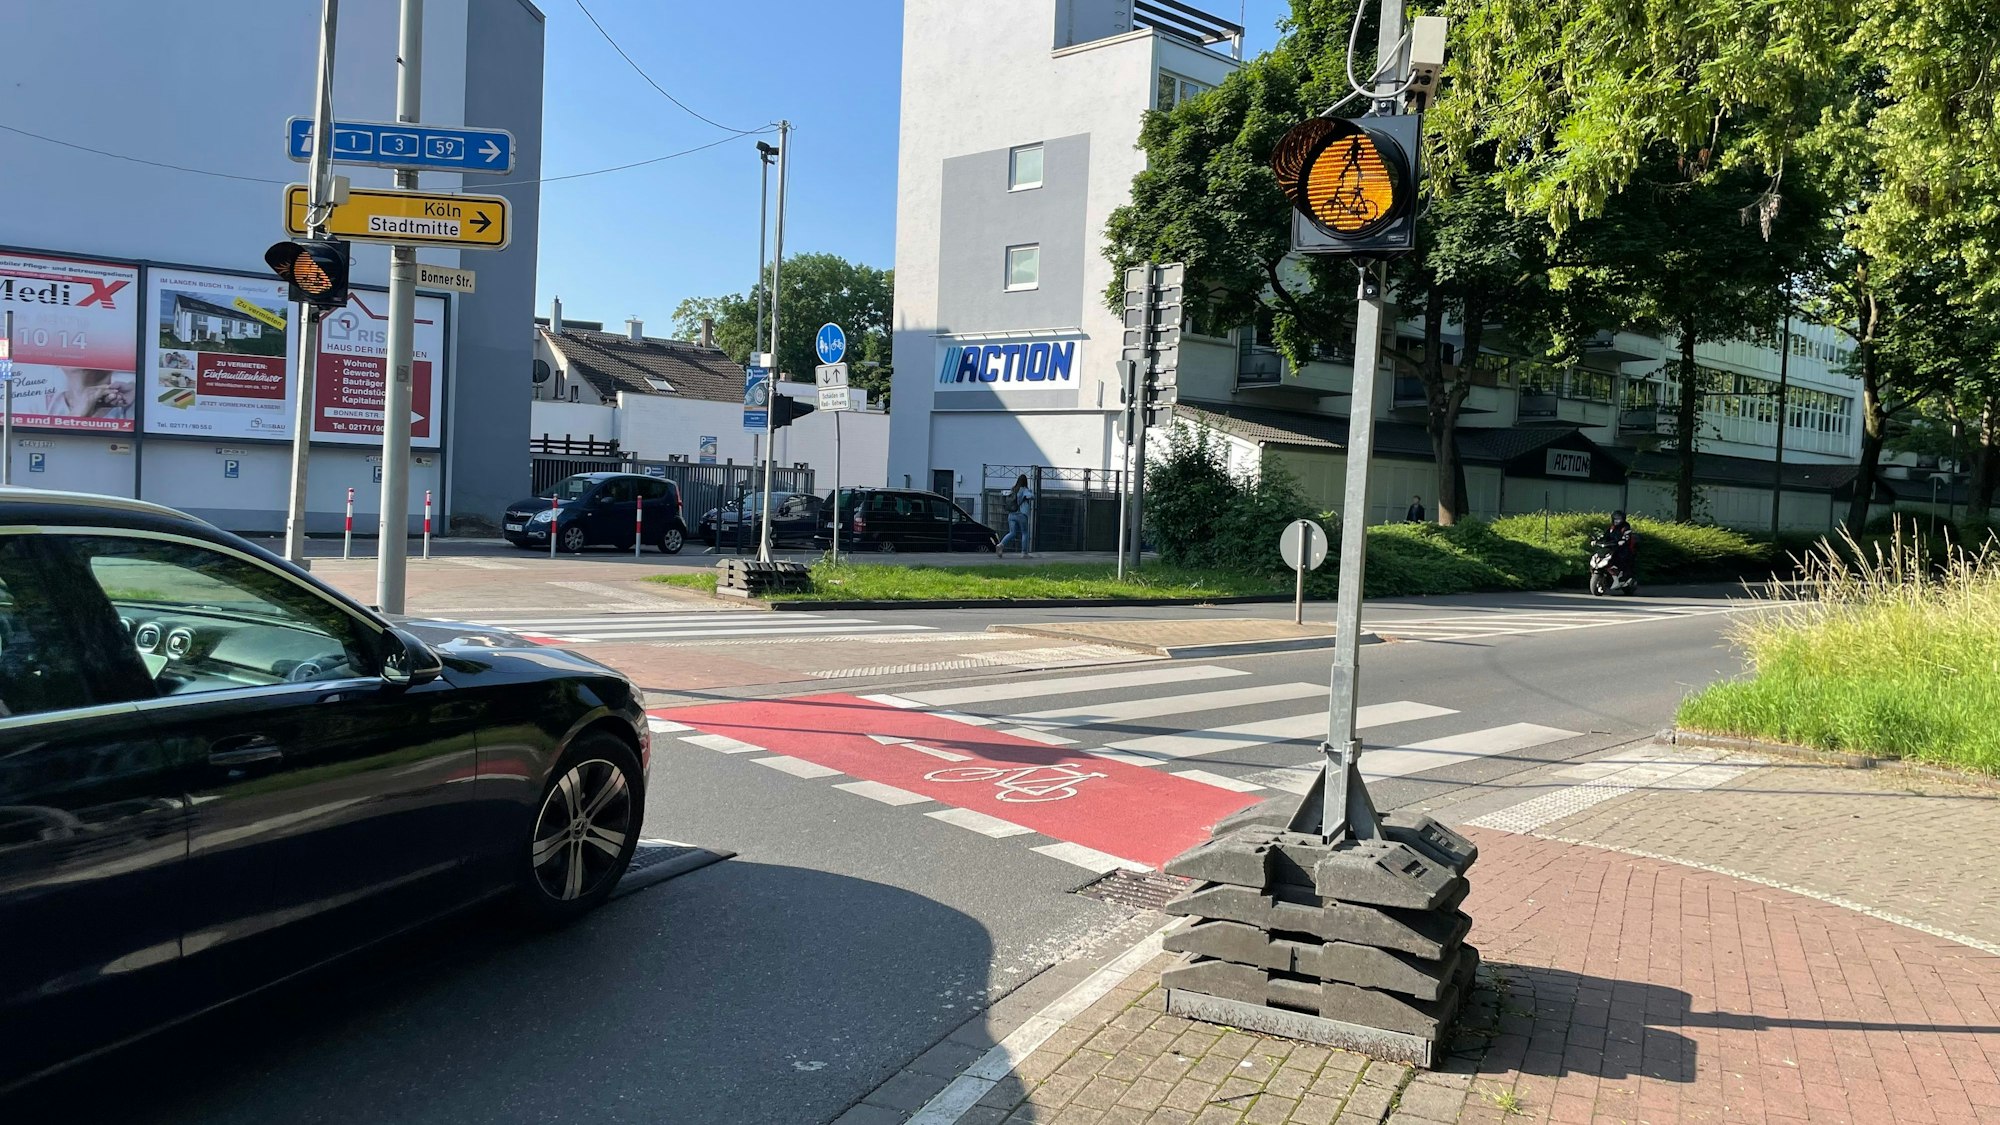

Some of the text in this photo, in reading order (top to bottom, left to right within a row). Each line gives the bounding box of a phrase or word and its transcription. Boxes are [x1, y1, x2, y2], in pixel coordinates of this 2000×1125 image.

[350, 135, 454, 155] 1 3 59
[424, 202, 461, 218] Köln
[370, 217, 459, 236] Stadtmitte
[199, 281, 222, 289] BUSCH
[421, 270, 472, 288] Bonner Str.
[236, 300, 283, 327] Zu vermieten
[19, 327, 49, 347] 10
[58, 330, 88, 350] 14
[327, 343, 353, 352] HAUS
[355, 345, 373, 354] DER
[343, 359, 378, 369] Wohnen
[955, 341, 1076, 383] ACTION
[203, 369, 283, 382] Einfamilienhäuser
[342, 368, 380, 379] Gewerbe
[746, 368, 754, 387] P
[342, 377, 384, 388] Bauträger
[342, 387, 387, 397] Grundstüc
[333, 409, 364, 418] BONNER
[27, 416, 50, 425] und
[54, 417, 119, 430] Betreuung
[332, 422, 347, 430] Tel.
[1553, 453, 1588, 473] ACTION
